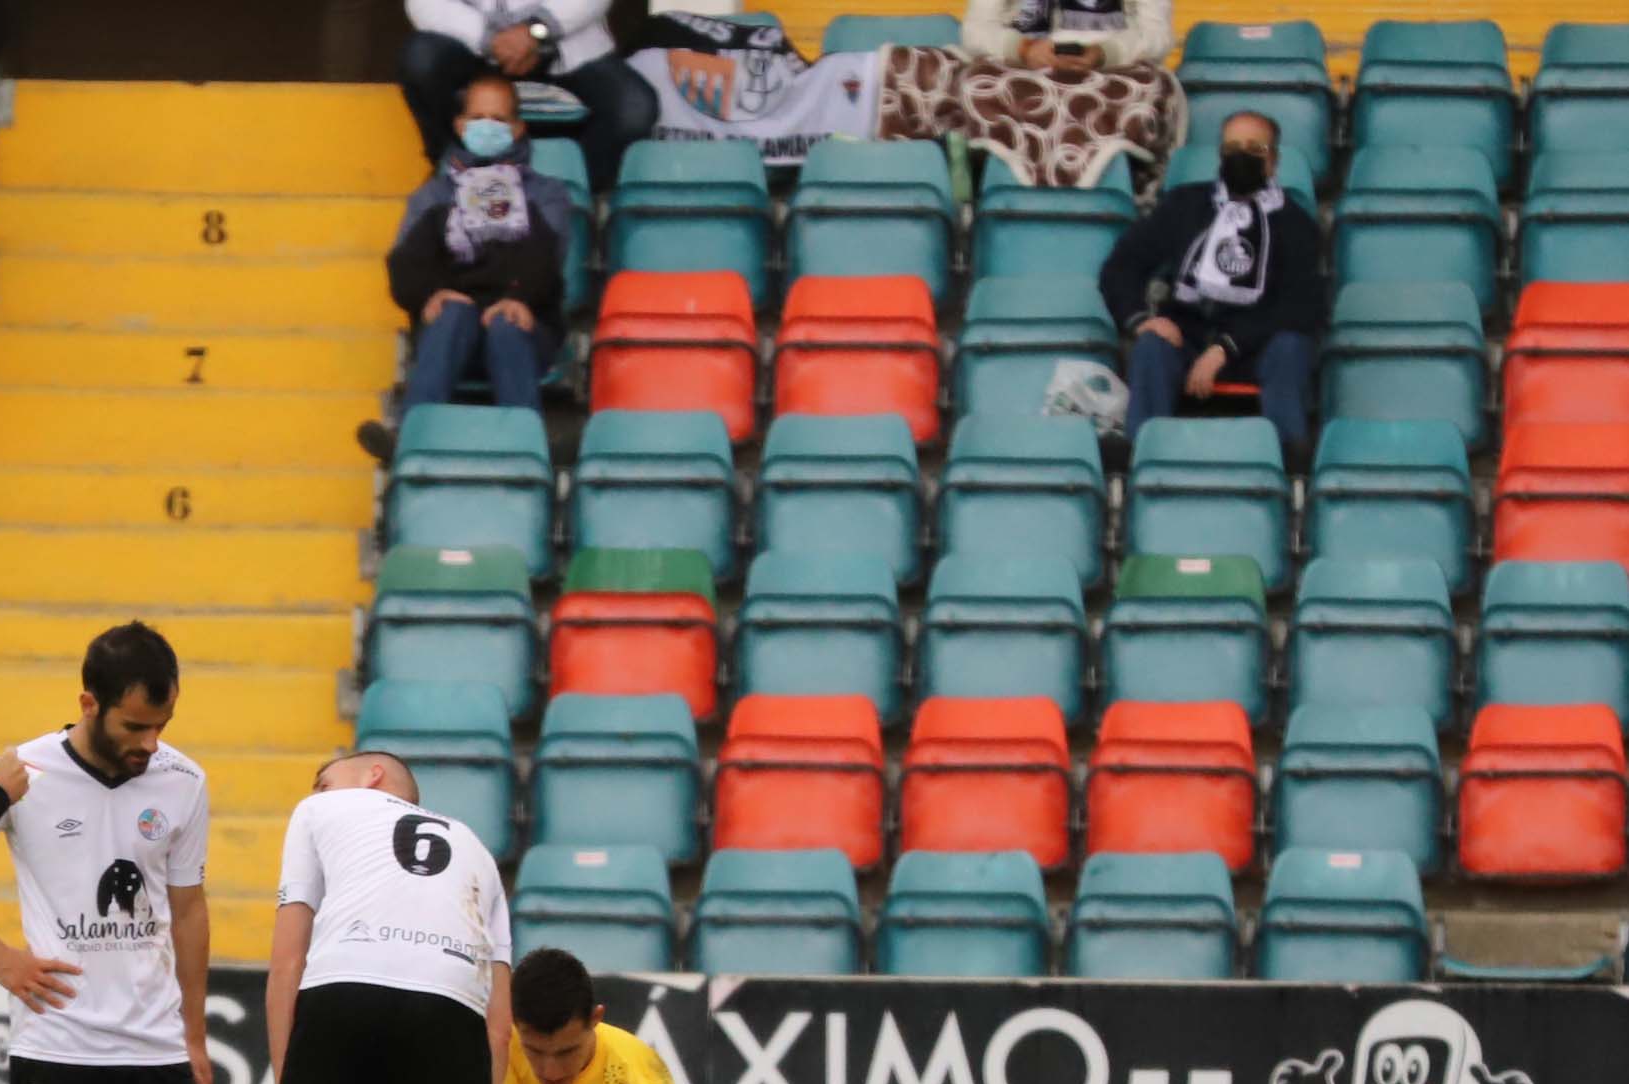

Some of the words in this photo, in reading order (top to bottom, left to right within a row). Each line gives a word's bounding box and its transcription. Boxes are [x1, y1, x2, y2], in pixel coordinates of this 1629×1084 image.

[201, 210, 227, 244] 8
[183, 347, 207, 384] 7
[165, 487, 191, 520] 6
[393, 814, 452, 876] 6
